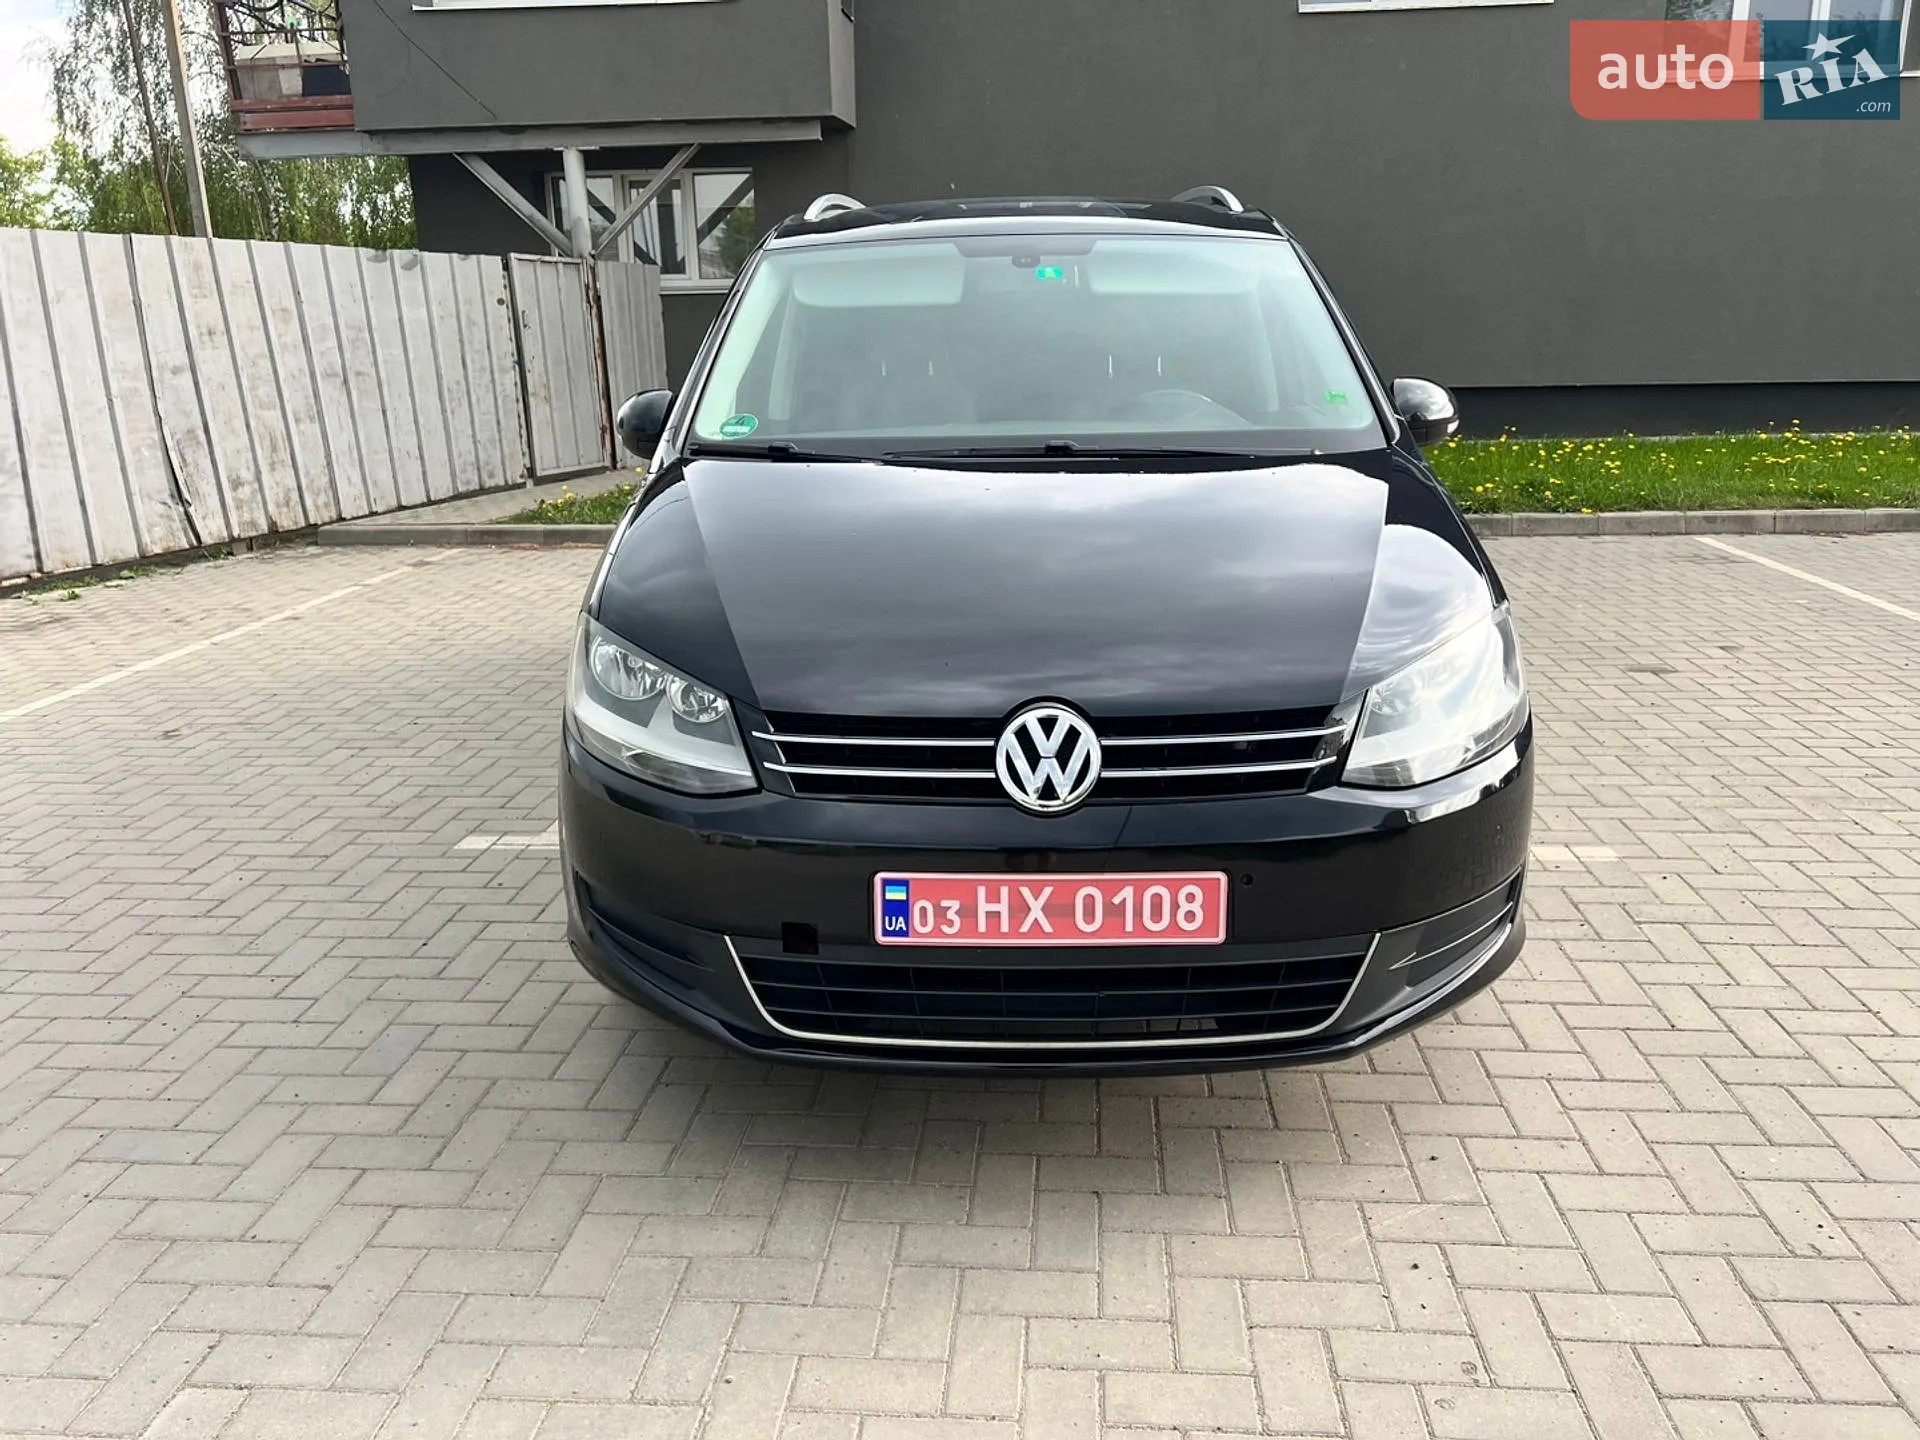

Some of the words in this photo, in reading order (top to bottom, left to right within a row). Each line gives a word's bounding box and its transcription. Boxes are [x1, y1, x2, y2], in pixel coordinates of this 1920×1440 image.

[885, 916, 906, 931] UA
[912, 899, 961, 935] 03
[976, 885, 1054, 933] HX
[1074, 884, 1204, 933] 0108
